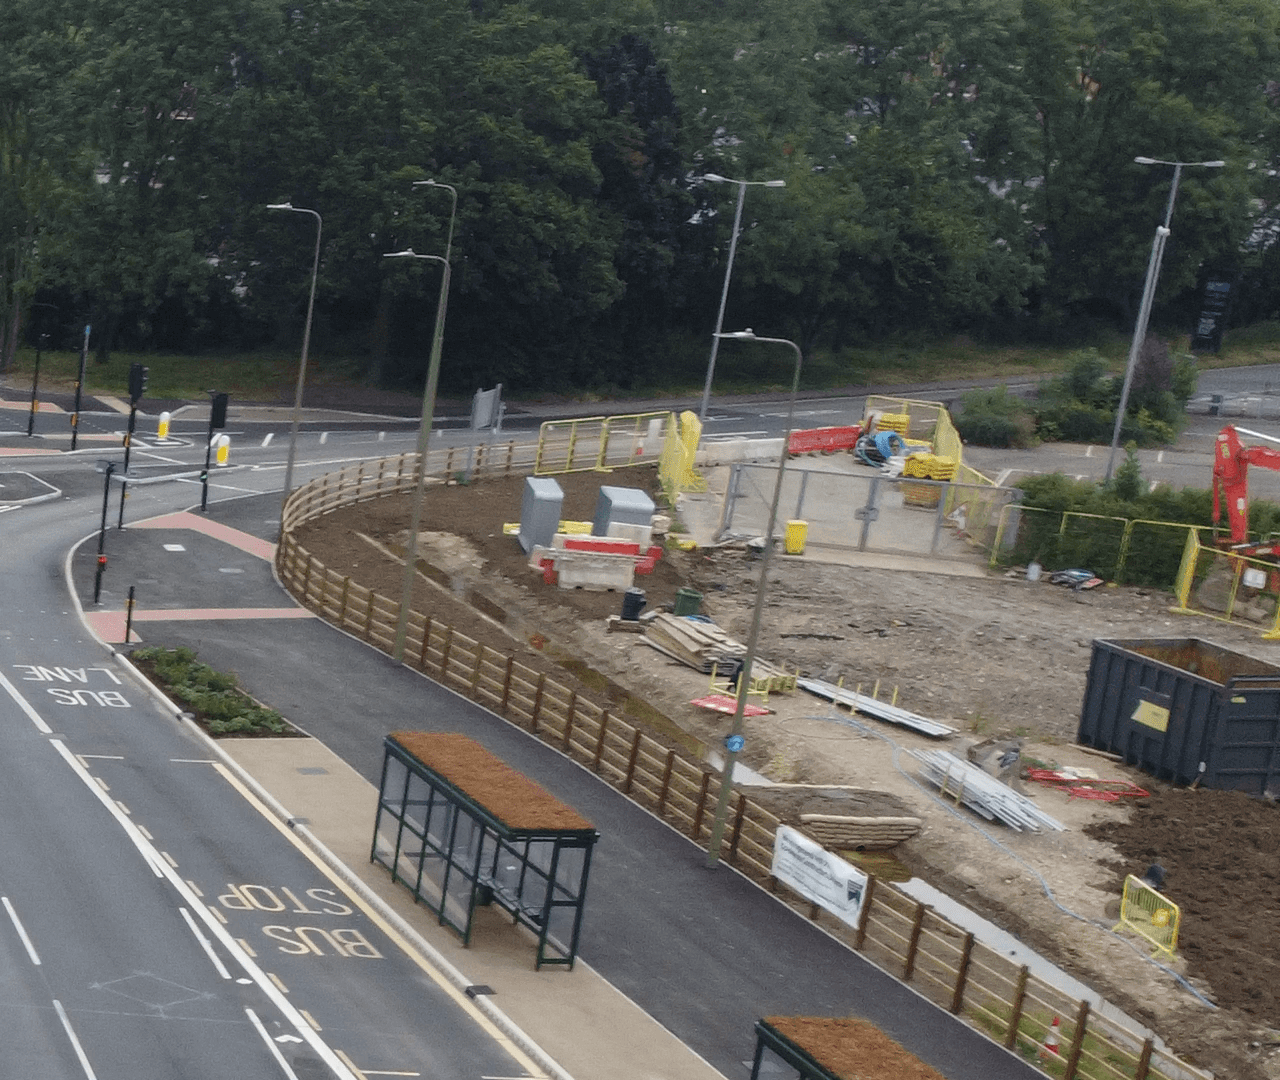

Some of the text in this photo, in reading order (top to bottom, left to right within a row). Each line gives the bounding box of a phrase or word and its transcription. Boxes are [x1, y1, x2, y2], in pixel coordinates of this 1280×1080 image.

[12, 664, 122, 685] LANE
[46, 688, 132, 708] BUS
[217, 883, 353, 916] STOP
[261, 925, 385, 959] BUS
